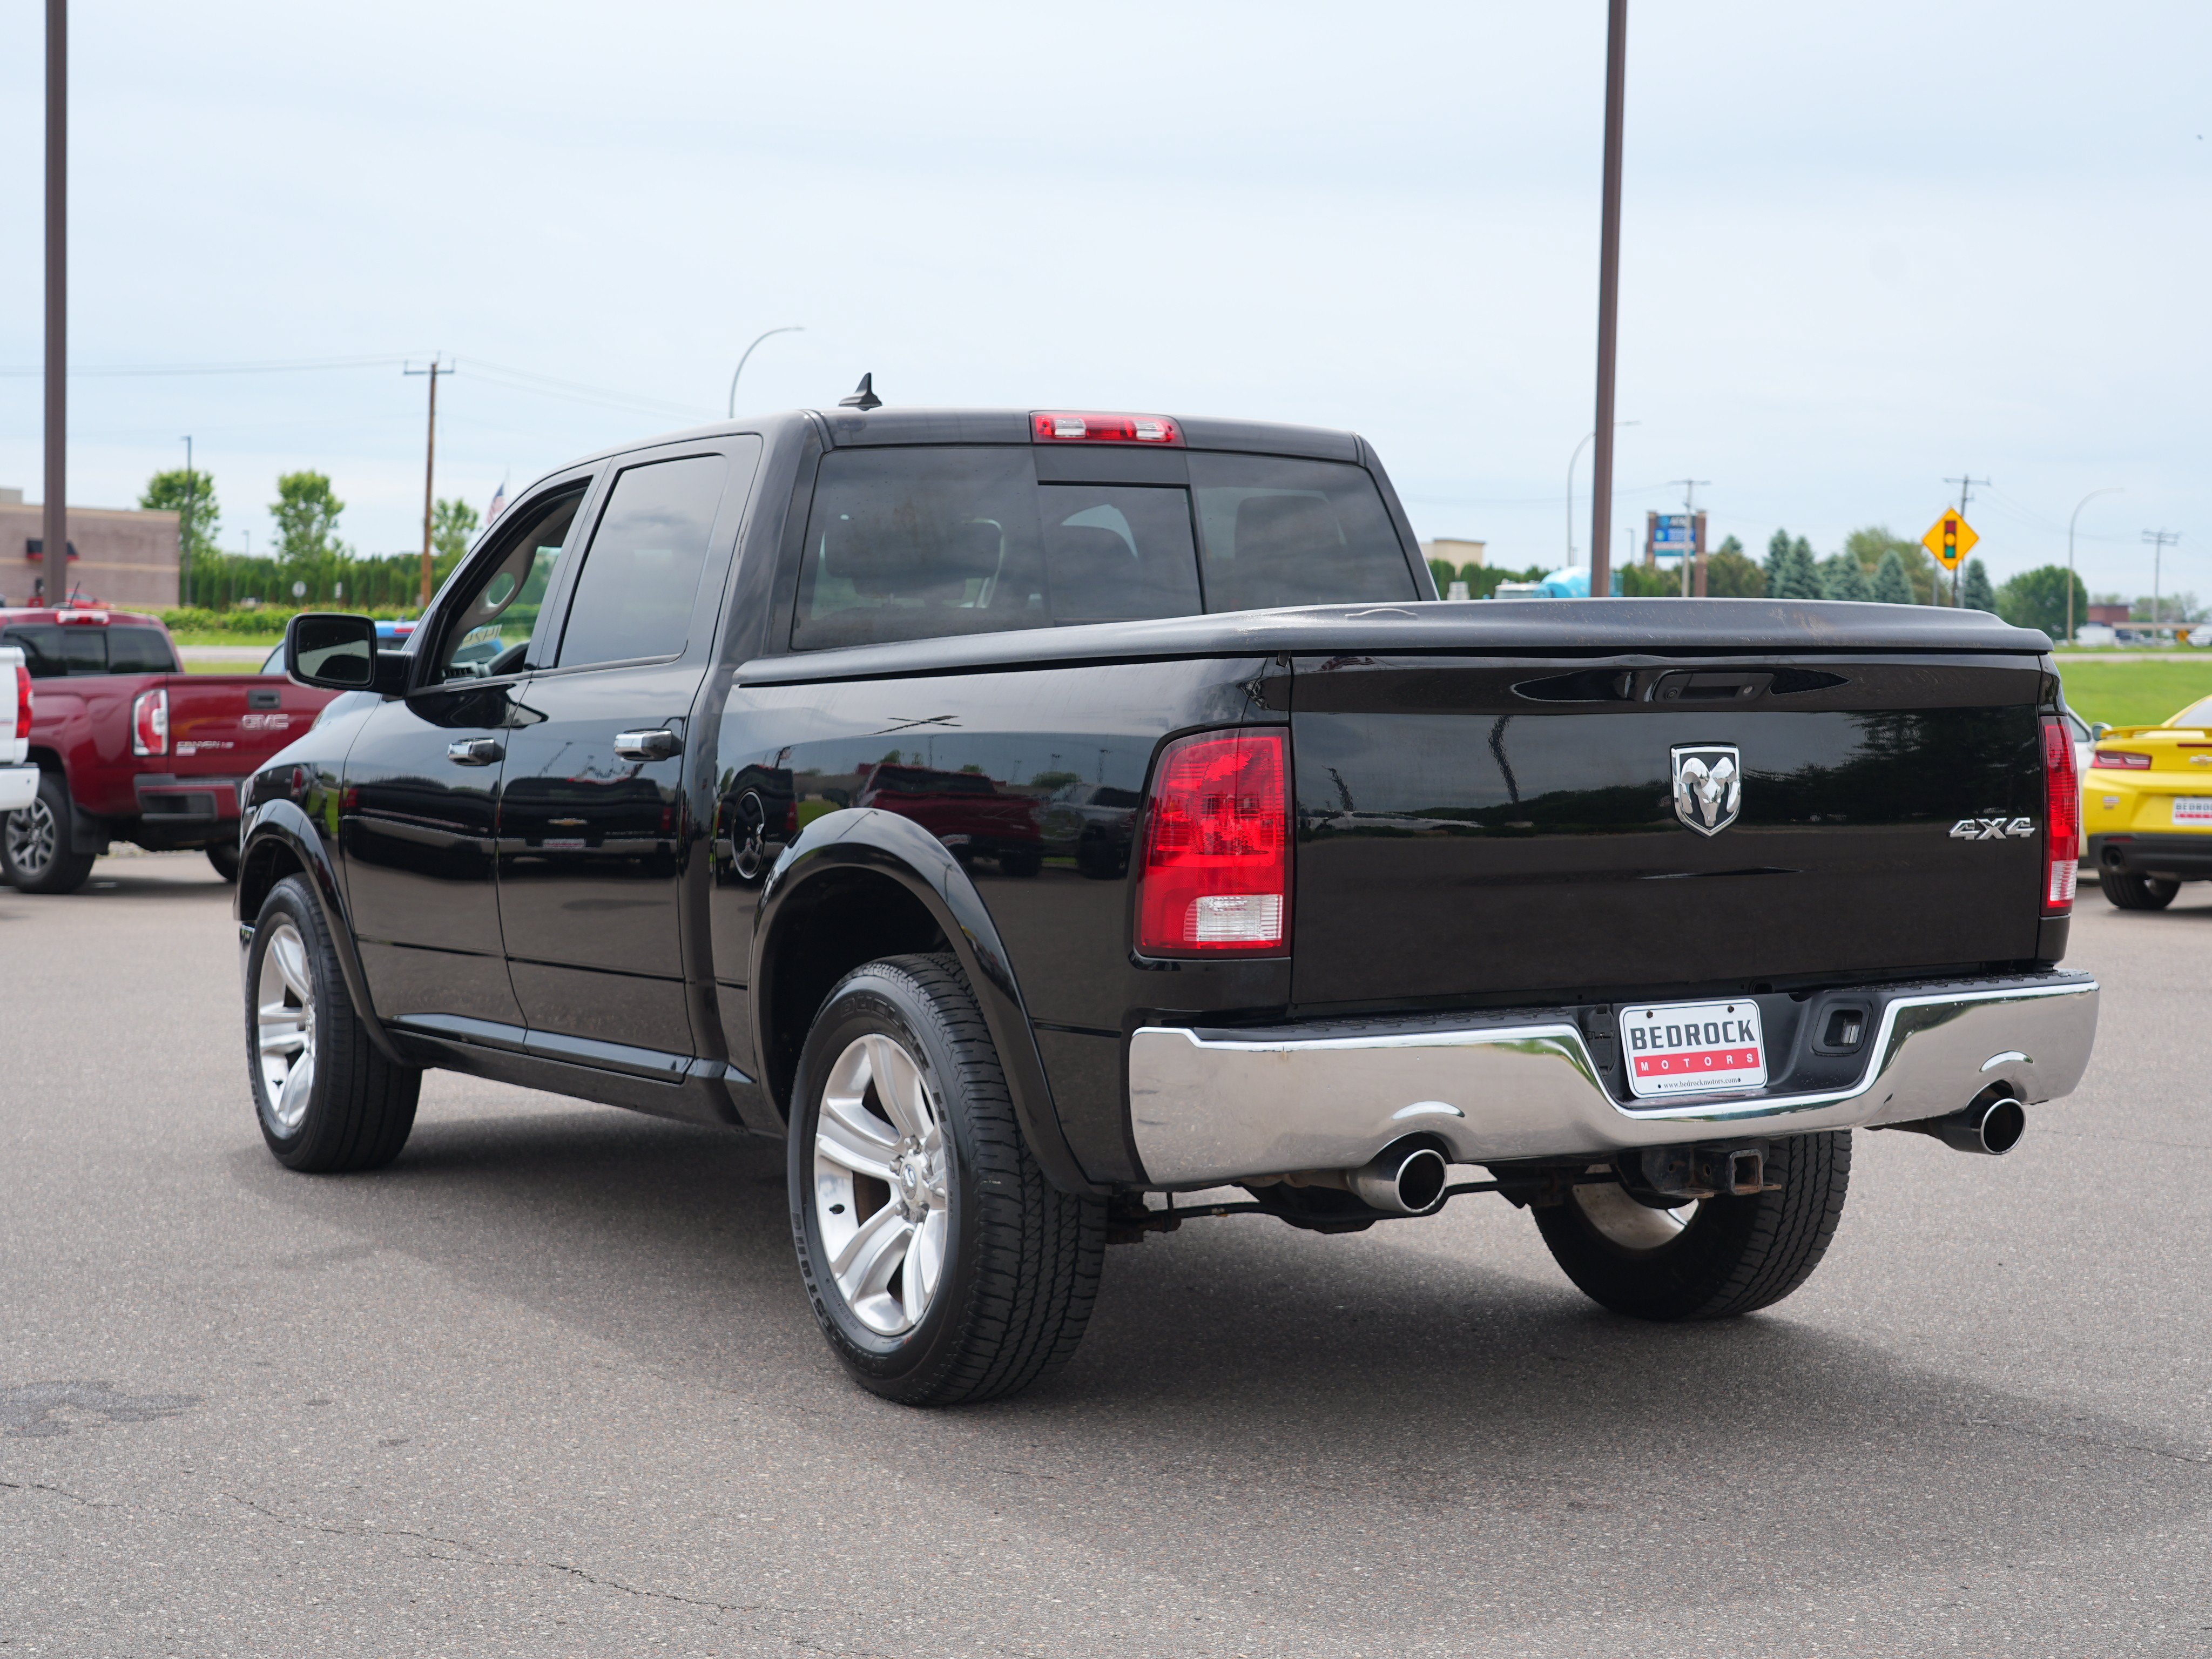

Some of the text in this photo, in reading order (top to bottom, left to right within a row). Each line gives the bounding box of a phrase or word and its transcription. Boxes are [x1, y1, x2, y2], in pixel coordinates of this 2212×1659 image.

[242, 714, 289, 730] GMC
[1630, 1020, 1755, 1050] BEDROCK
[1641, 1053, 1754, 1071] MOTORS
[1664, 1077, 1737, 1089] www.bedrockmotors.com
